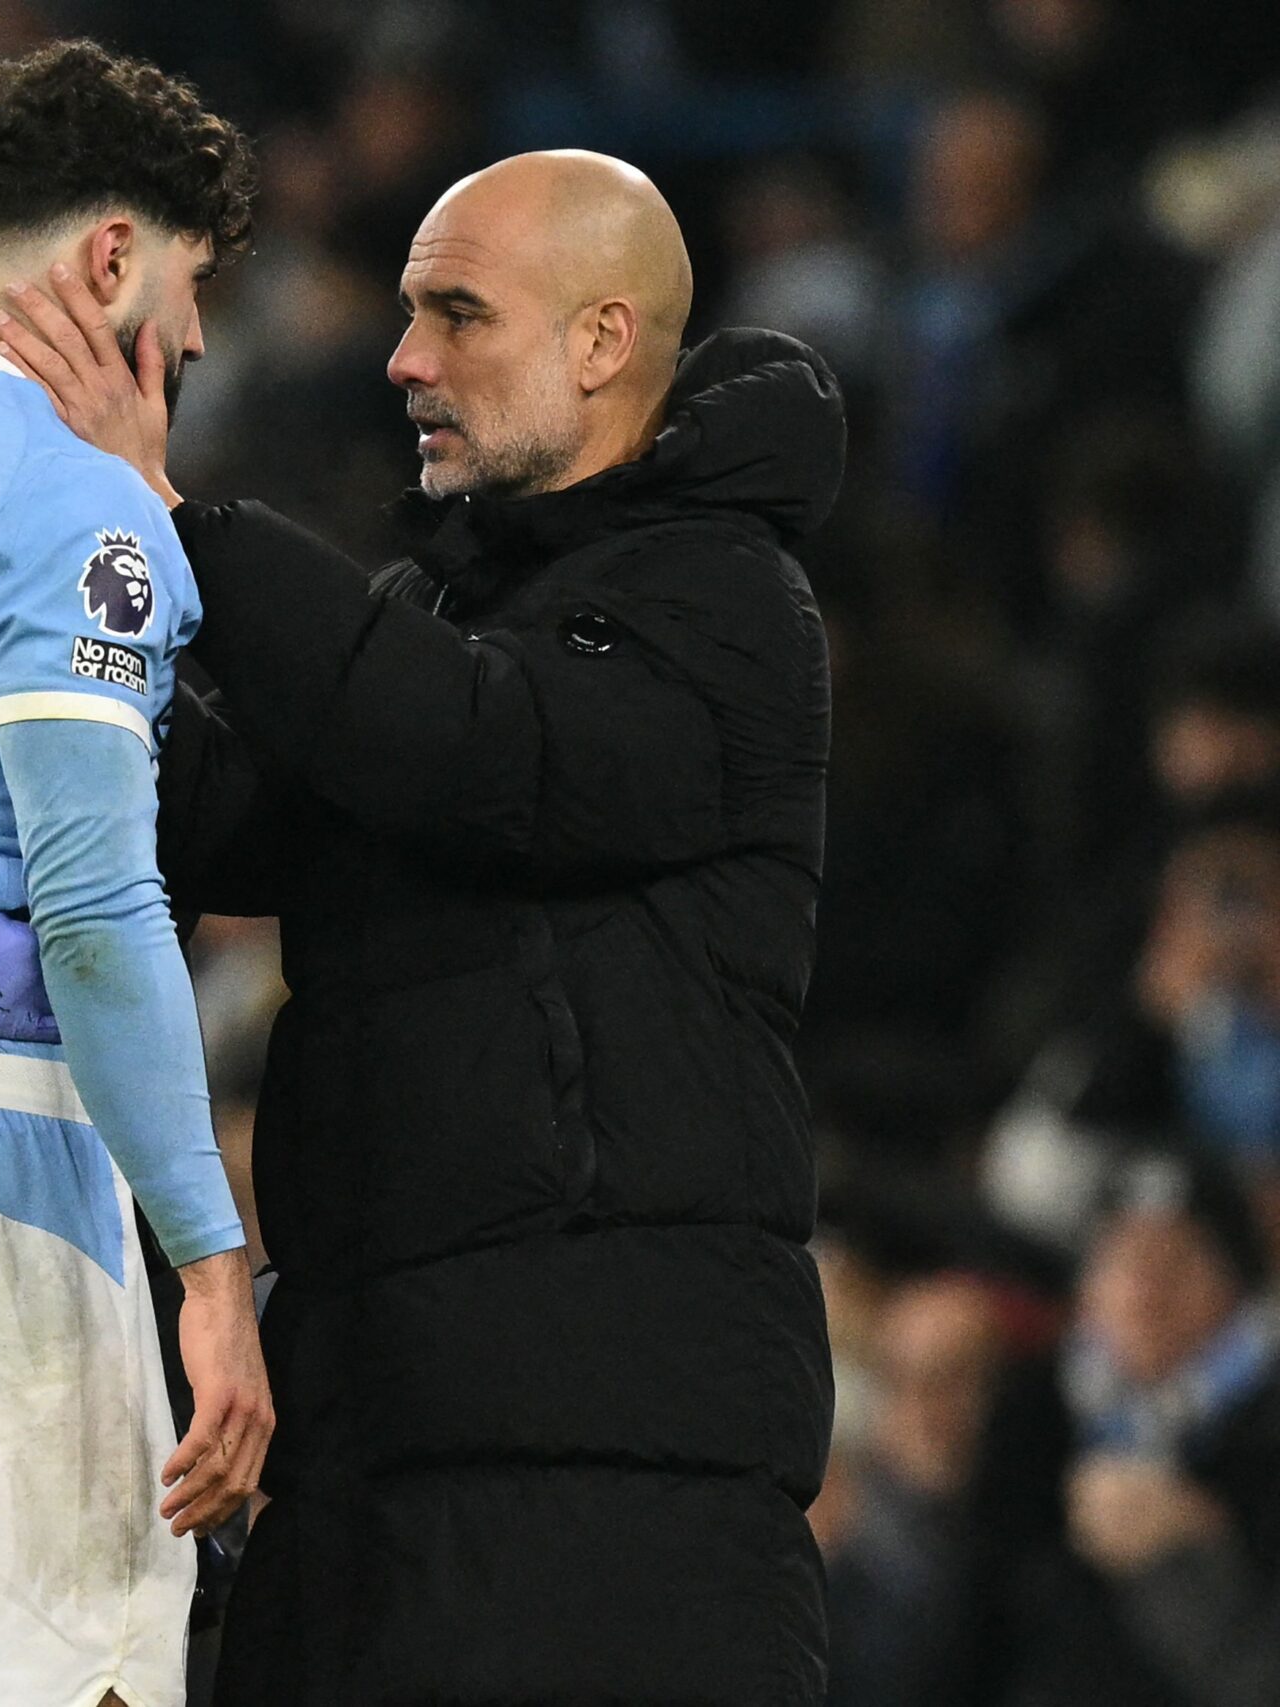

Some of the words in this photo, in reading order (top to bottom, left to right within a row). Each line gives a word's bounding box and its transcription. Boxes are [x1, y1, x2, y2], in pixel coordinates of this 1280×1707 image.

[72, 656, 102, 678] for
[73, 637, 105, 661] No
[108, 647, 142, 675] room
